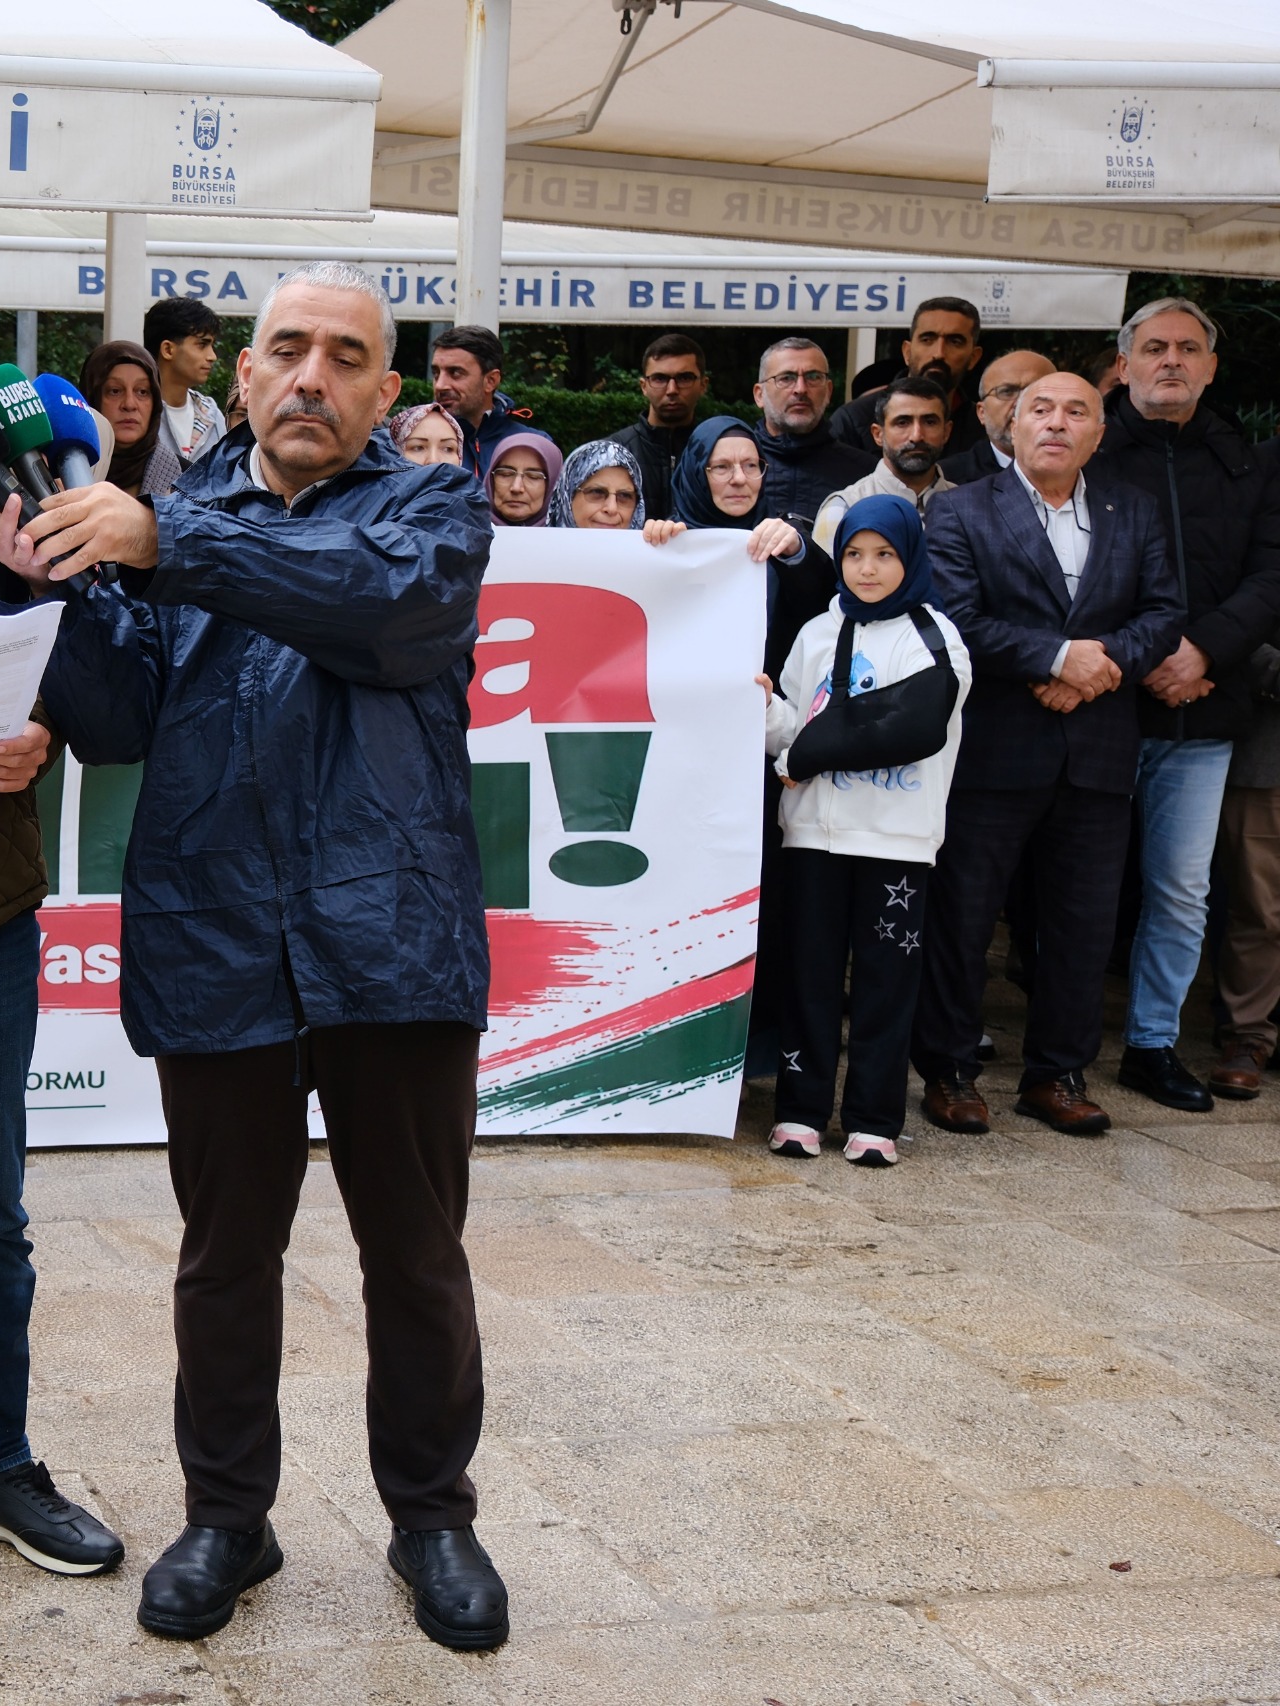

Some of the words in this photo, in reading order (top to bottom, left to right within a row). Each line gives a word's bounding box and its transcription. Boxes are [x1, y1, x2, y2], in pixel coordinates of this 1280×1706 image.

[1105, 155, 1155, 168] BURSA
[172, 164, 236, 181] BURSA
[172, 180, 236, 193] BÜYÜKŞEHİR
[1105, 178, 1155, 189] BELEDİYESİ
[172, 192, 236, 205] BELEDİYESİ
[78, 265, 249, 300] BRSA
[628, 274, 907, 312] BELEDİYESİ
